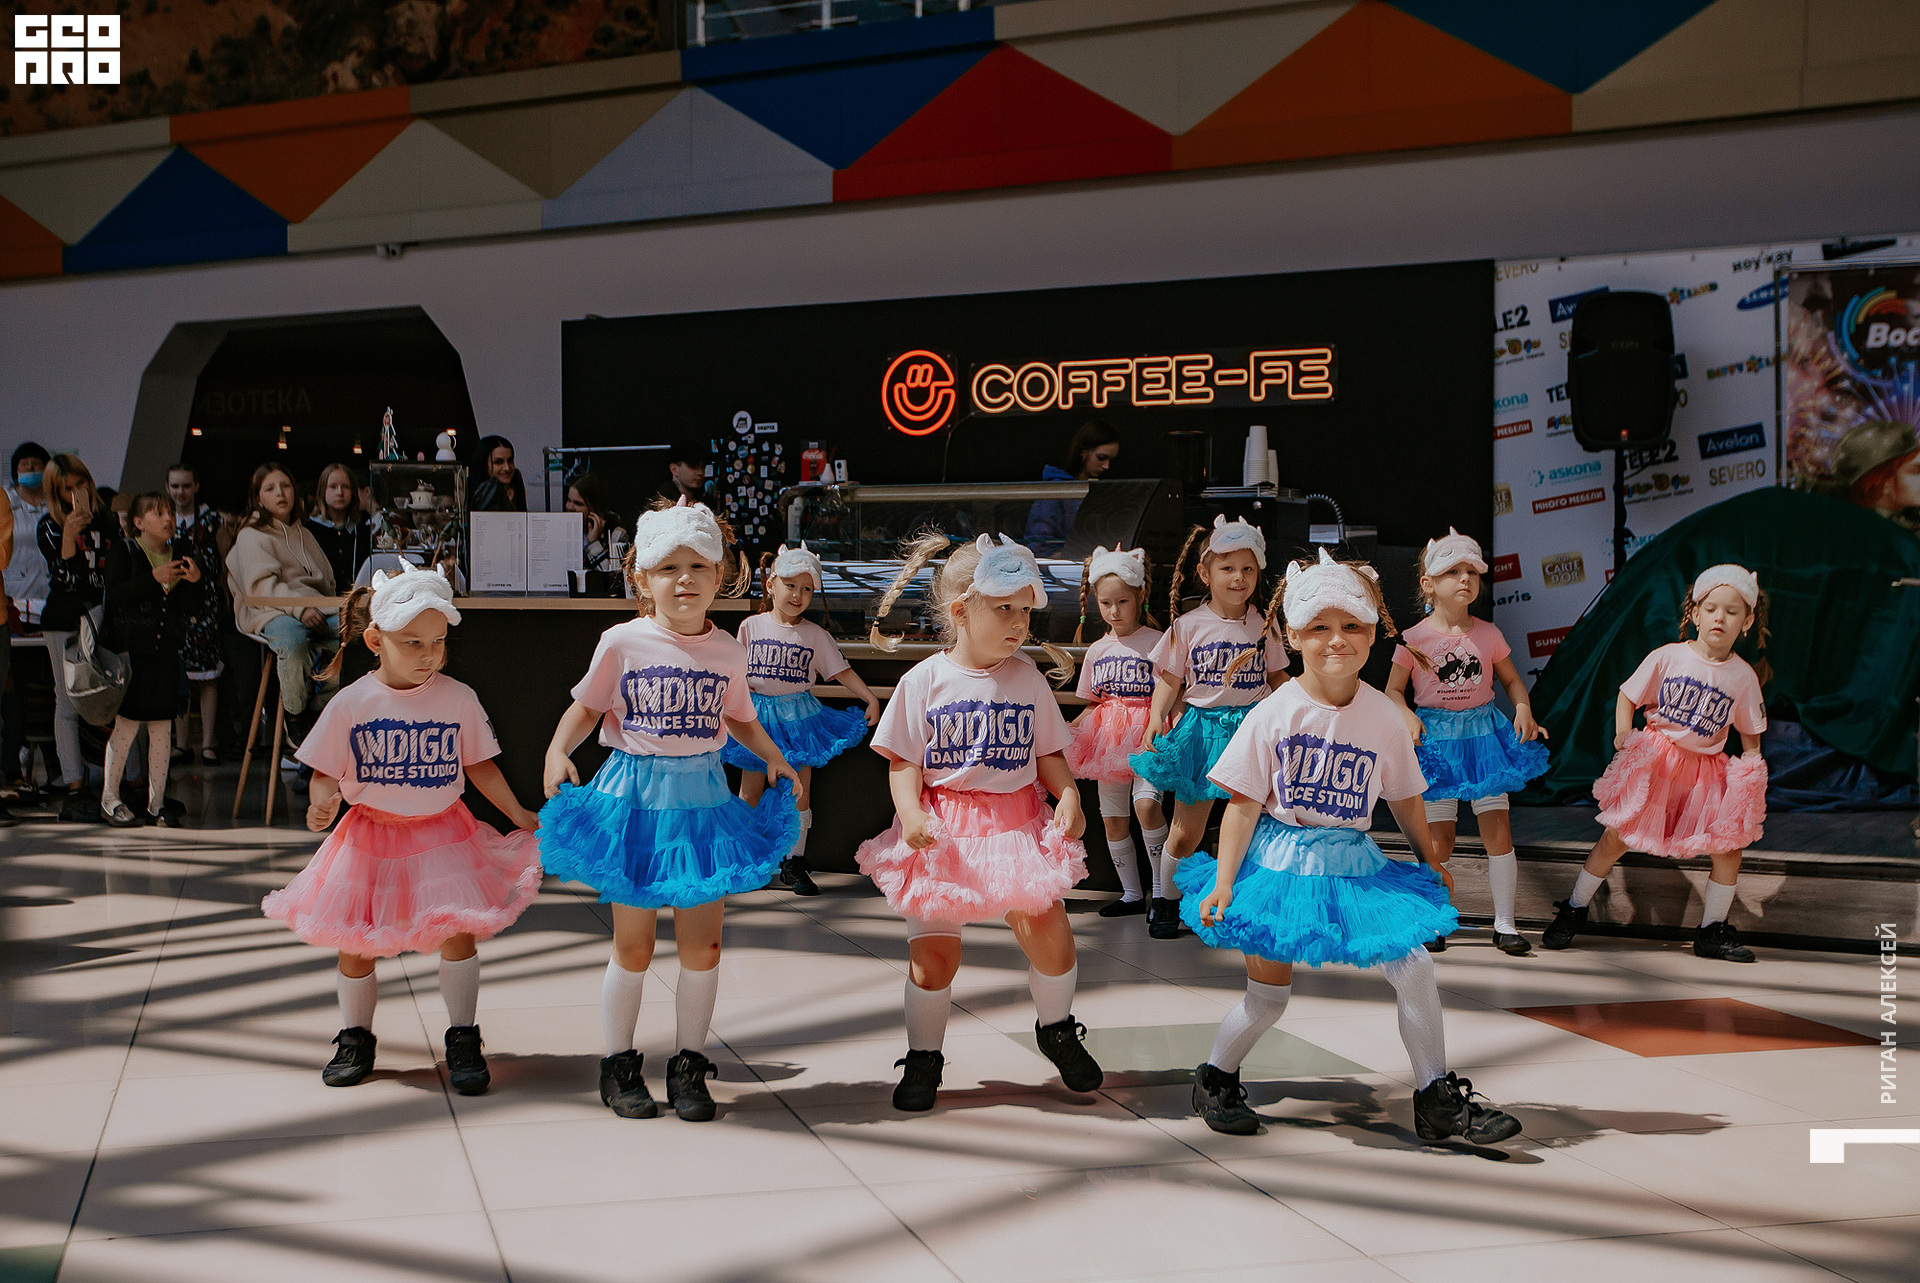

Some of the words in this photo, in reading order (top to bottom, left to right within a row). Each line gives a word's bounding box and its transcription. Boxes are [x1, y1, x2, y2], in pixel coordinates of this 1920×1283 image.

[971, 347, 1333, 413] COFFEE-FE
[1706, 432, 1760, 453] Avelon
[1549, 460, 1602, 480] askona
[1708, 459, 1766, 486] SEVERO
[1534, 497, 1568, 512] МНОГО
[1568, 490, 1604, 506] МЕБЕЛИ
[1545, 559, 1581, 575] CARTE
[748, 643, 812, 670] INDIGO
[1091, 659, 1150, 688] INDIGO
[626, 676, 728, 714] INDIGO
[1114, 683, 1151, 693] STUDIO
[1663, 682, 1730, 724] INDIGO
[630, 714, 683, 730] DANCE
[931, 709, 1035, 749] INDIGO
[355, 727, 459, 764] INDIGO
[930, 747, 983, 764] DANCE
[985, 746, 1030, 761] STUDIO
[407, 763, 457, 779] STUDIO
